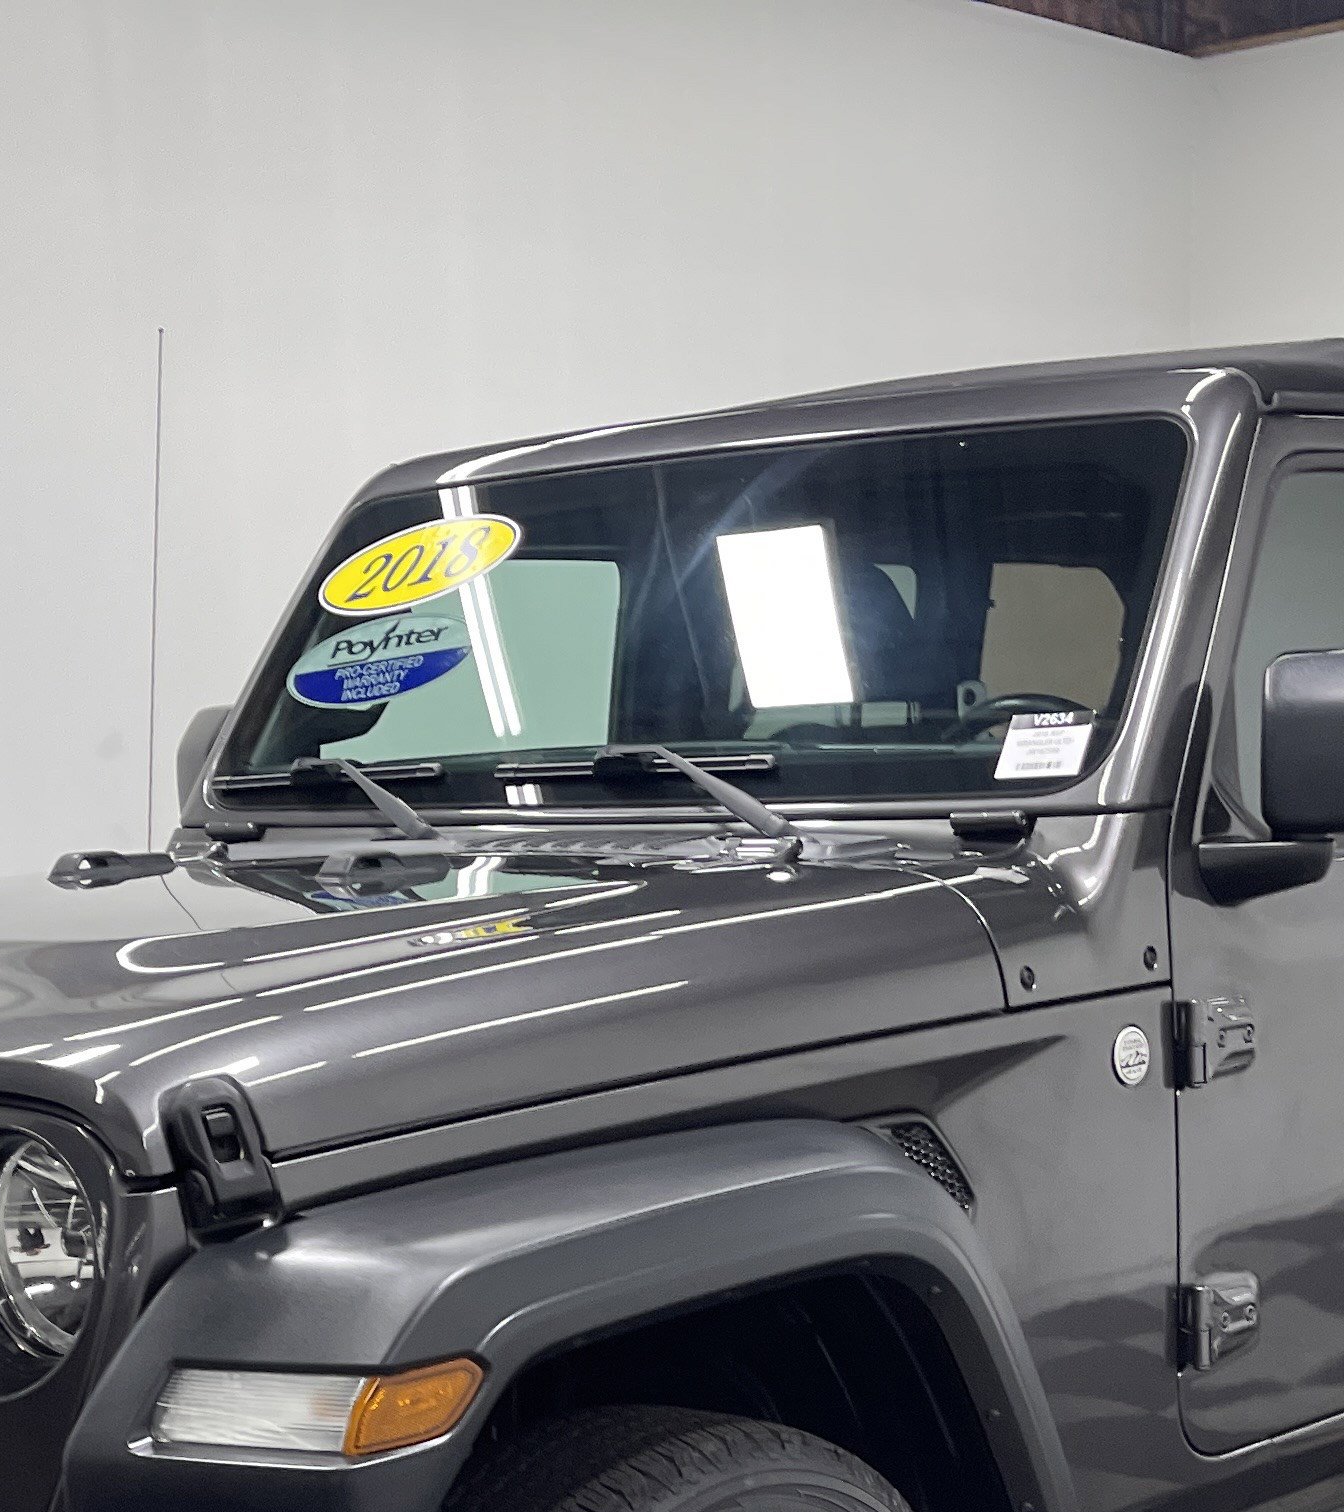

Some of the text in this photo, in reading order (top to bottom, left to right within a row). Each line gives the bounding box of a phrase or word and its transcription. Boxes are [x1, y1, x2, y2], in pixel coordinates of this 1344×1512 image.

[344, 525, 491, 603] 2018
[330, 624, 449, 664] Poynter
[340, 681, 400, 701] INCLUDED
[1033, 711, 1075, 726] V2634
